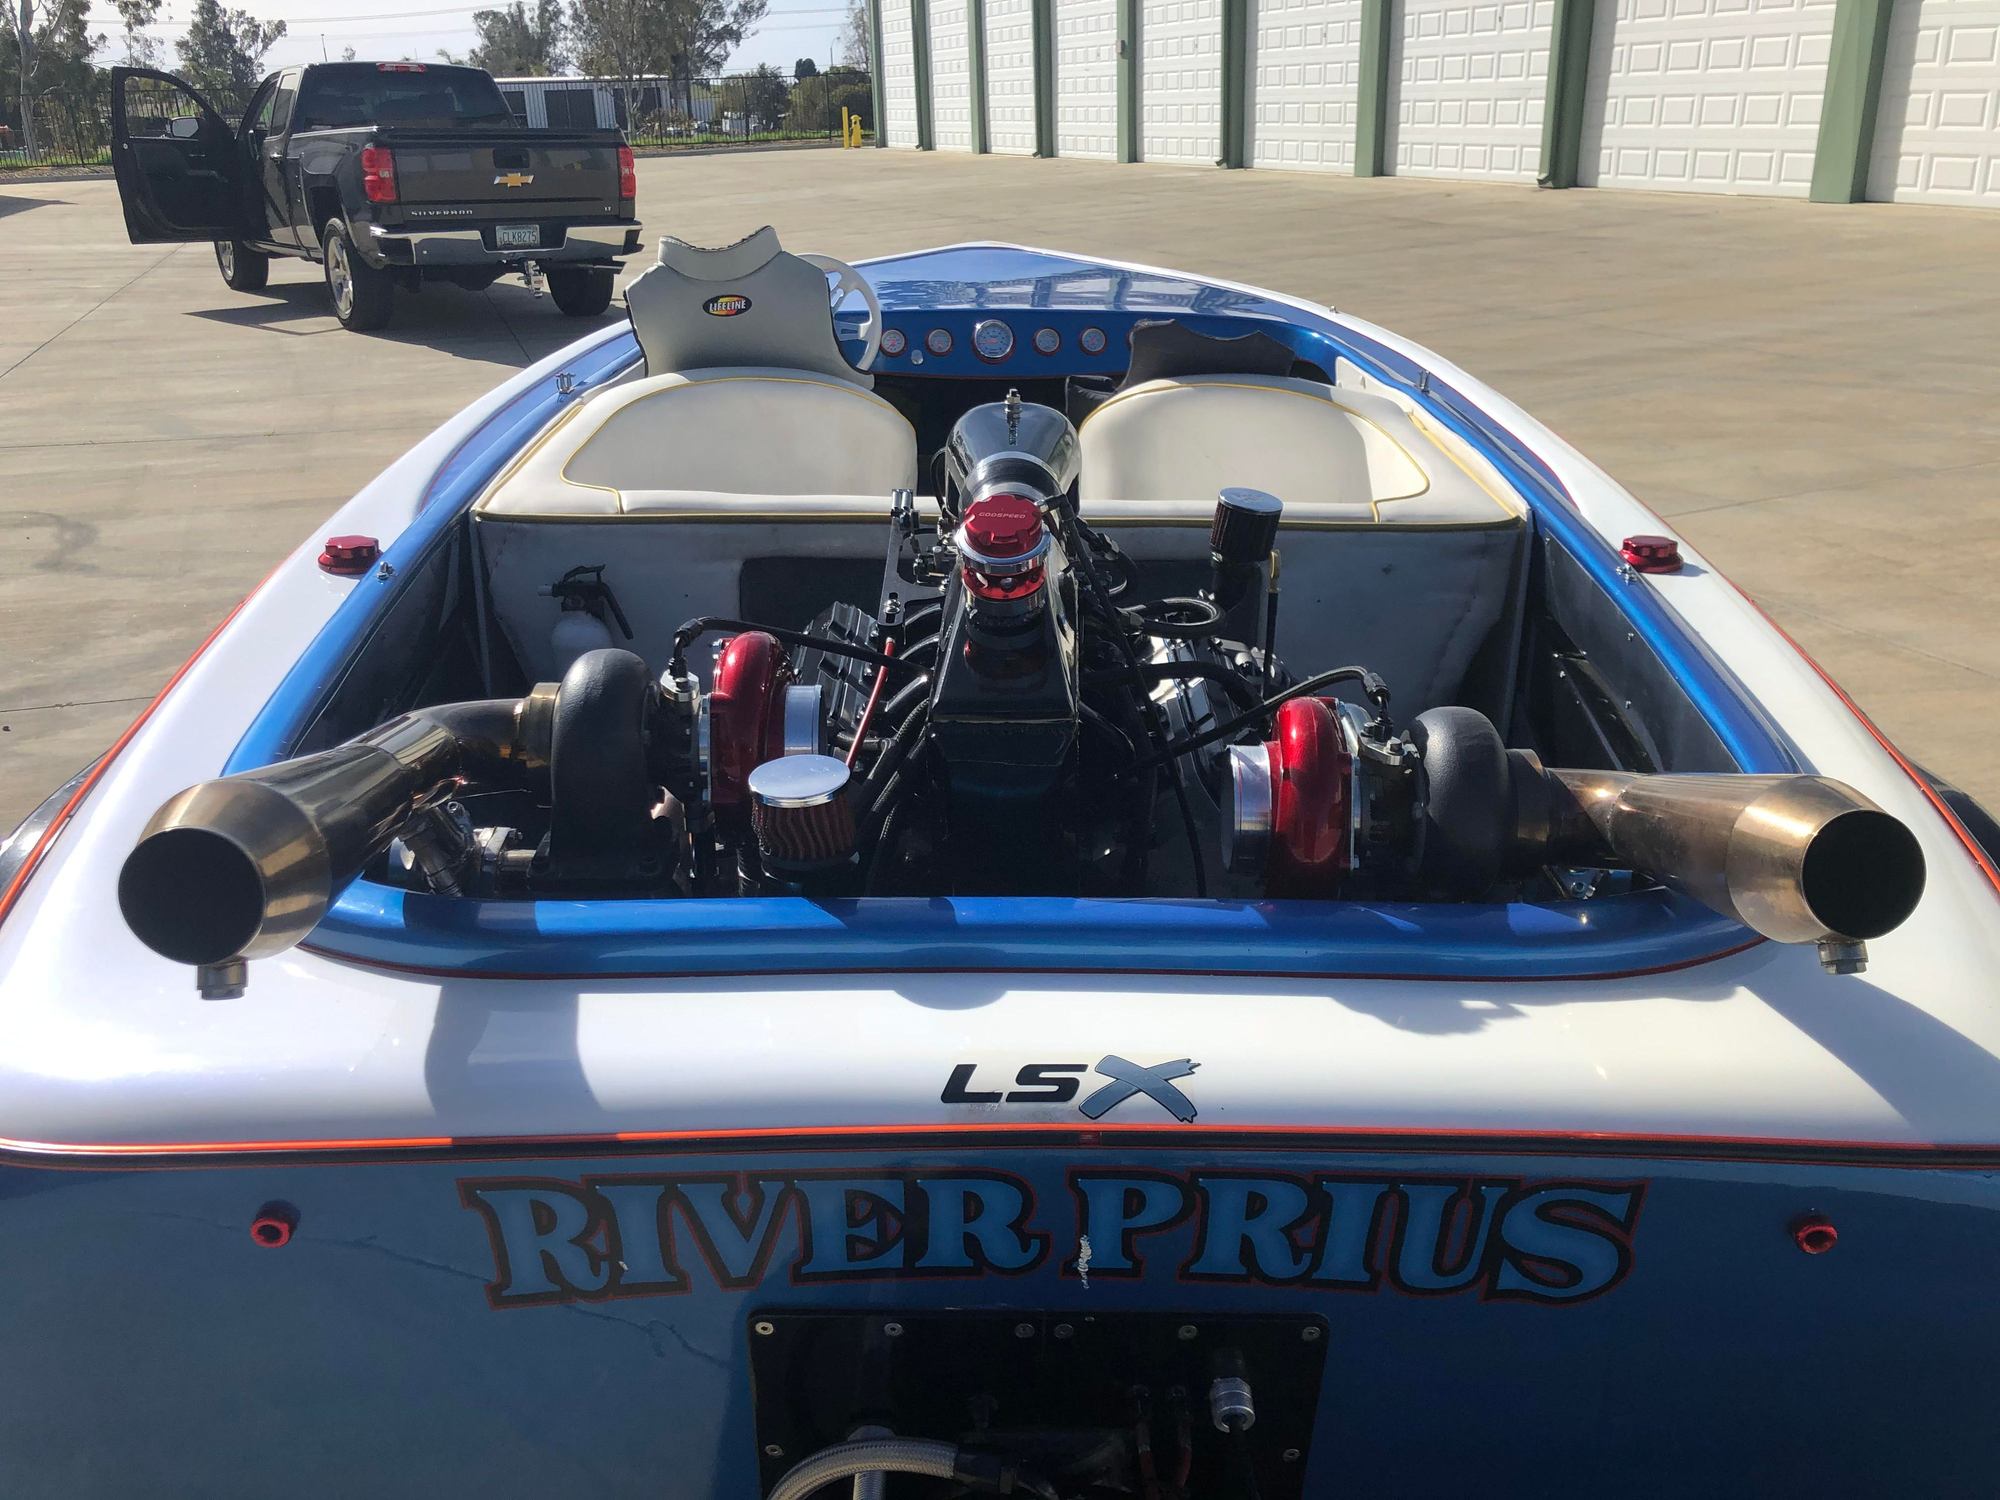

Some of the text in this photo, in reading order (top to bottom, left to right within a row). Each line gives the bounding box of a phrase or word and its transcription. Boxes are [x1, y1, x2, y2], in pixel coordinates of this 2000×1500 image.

[709, 299, 746, 312] LIFELINE
[978, 511, 1026, 519] GODSPEED
[940, 1054, 1202, 1124] LSX
[459, 1168, 1647, 1307] RIVER PRIUS
